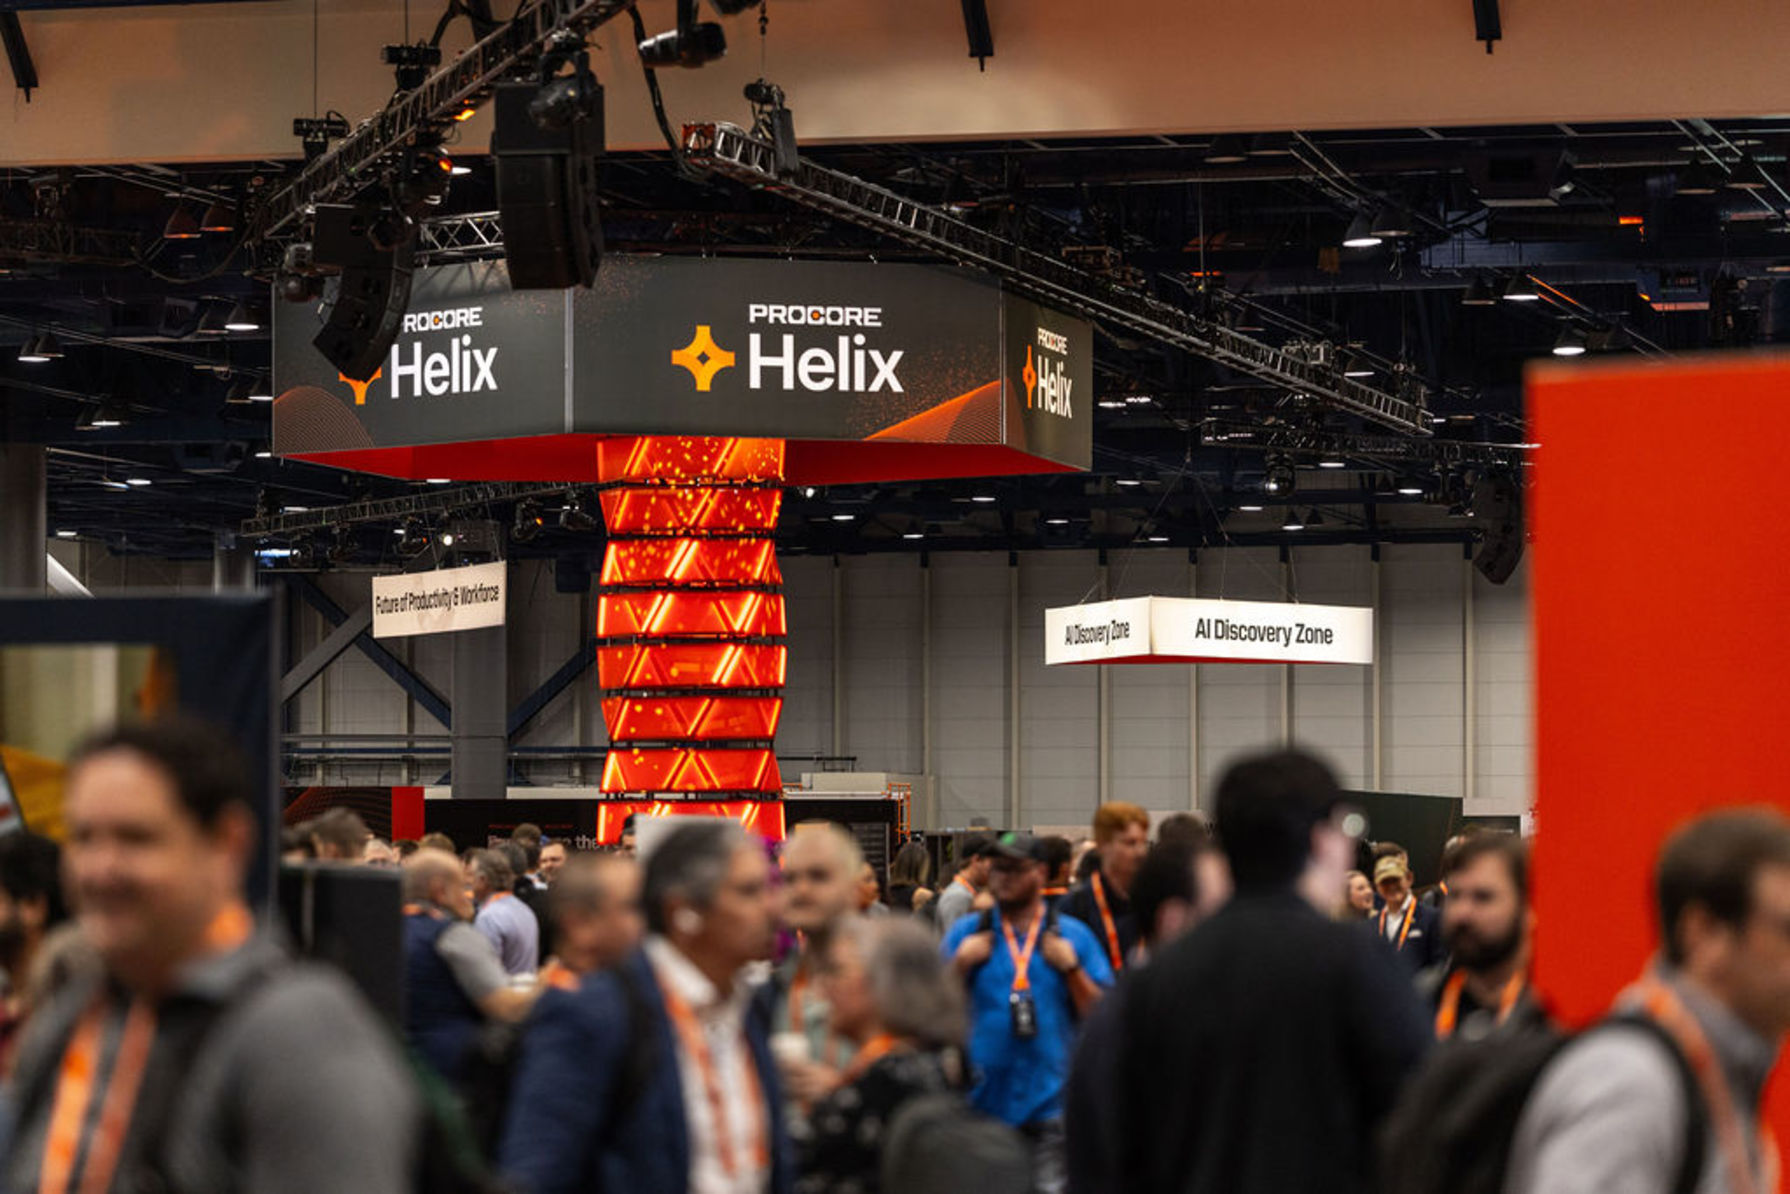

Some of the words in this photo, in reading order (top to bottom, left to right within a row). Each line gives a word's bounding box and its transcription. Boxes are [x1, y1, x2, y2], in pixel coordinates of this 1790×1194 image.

[402, 306, 483, 333] ROCORE
[748, 303, 882, 327] PROCORE
[1037, 327, 1067, 355] PROCORE
[391, 333, 498, 399] Helix
[748, 333, 904, 393] Helix
[1037, 354, 1072, 419] Helix
[376, 595, 399, 615] Future
[400, 592, 408, 612] of
[409, 588, 453, 611] Productivity
[453, 586, 459, 606] &
[460, 583, 499, 606] Workforce
[1064, 625, 1073, 645] AI
[1075, 624, 1110, 645] Discovery
[1111, 619, 1129, 640] Zone
[1195, 617, 1211, 639] AI
[1214, 619, 1292, 648] Discovery
[1295, 623, 1333, 644] Zone
